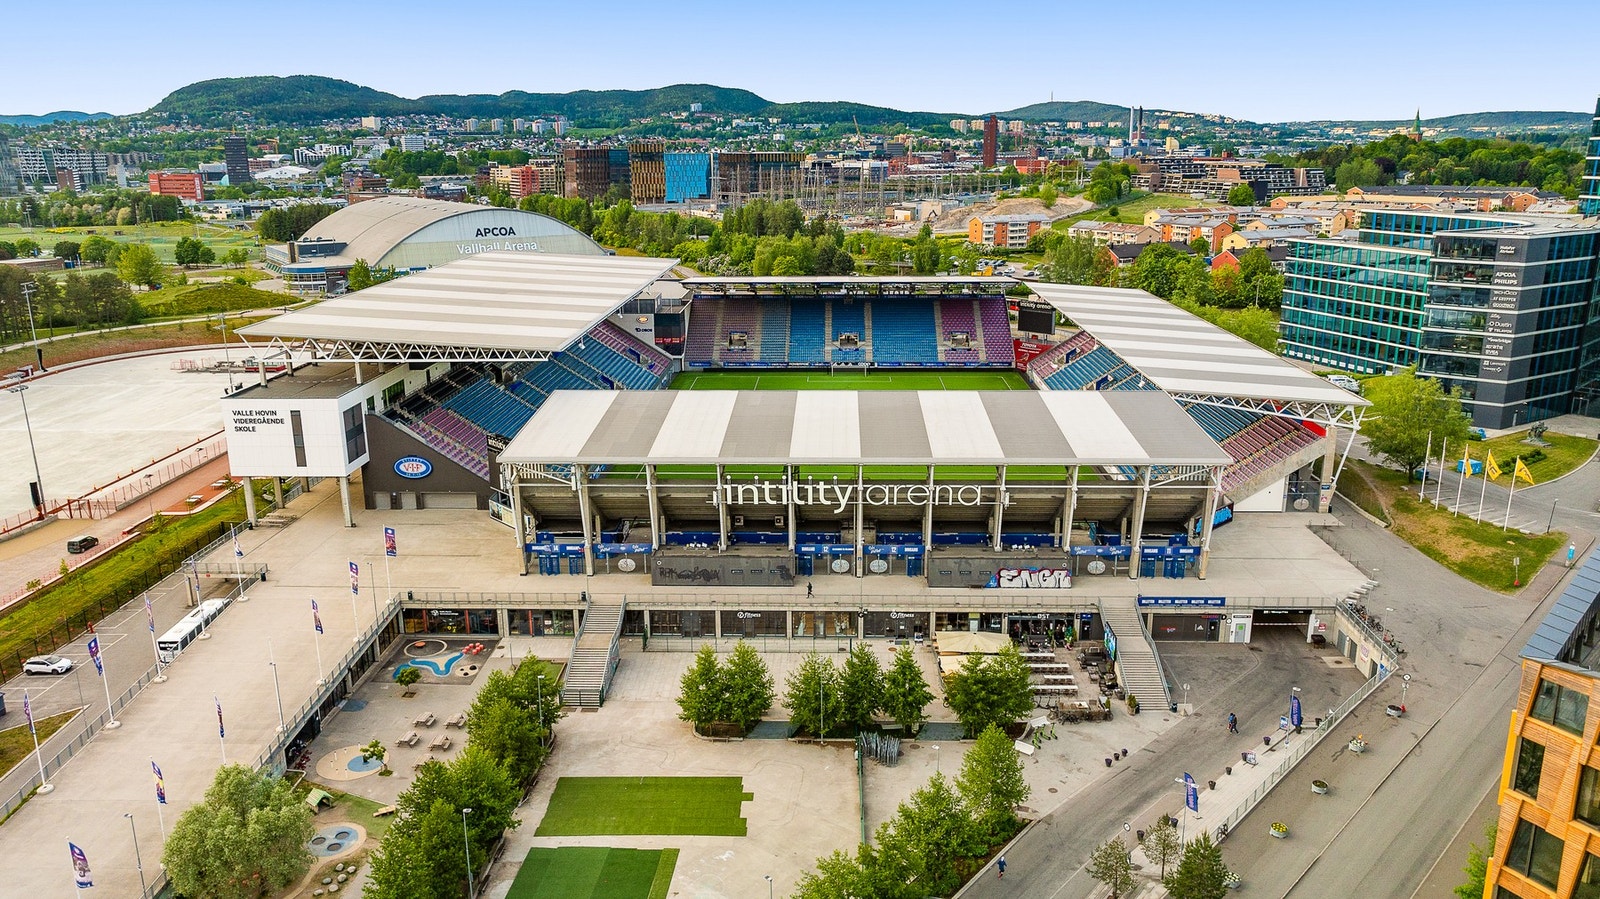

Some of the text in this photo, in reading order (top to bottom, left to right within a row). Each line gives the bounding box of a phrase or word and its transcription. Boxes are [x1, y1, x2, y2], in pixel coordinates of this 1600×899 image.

[475, 226, 517, 237] APCOA
[456, 241, 538, 254] Vallhall Arena
[231, 409, 277, 417] VALLE HOVIN
[233, 417, 285, 425] VIDEREGÅENDE
[234, 425, 257, 433] SKOLE
[723, 475, 982, 514] intility arena
[743, 611, 761, 619] fitness
[898, 611, 915, 619] fitness
